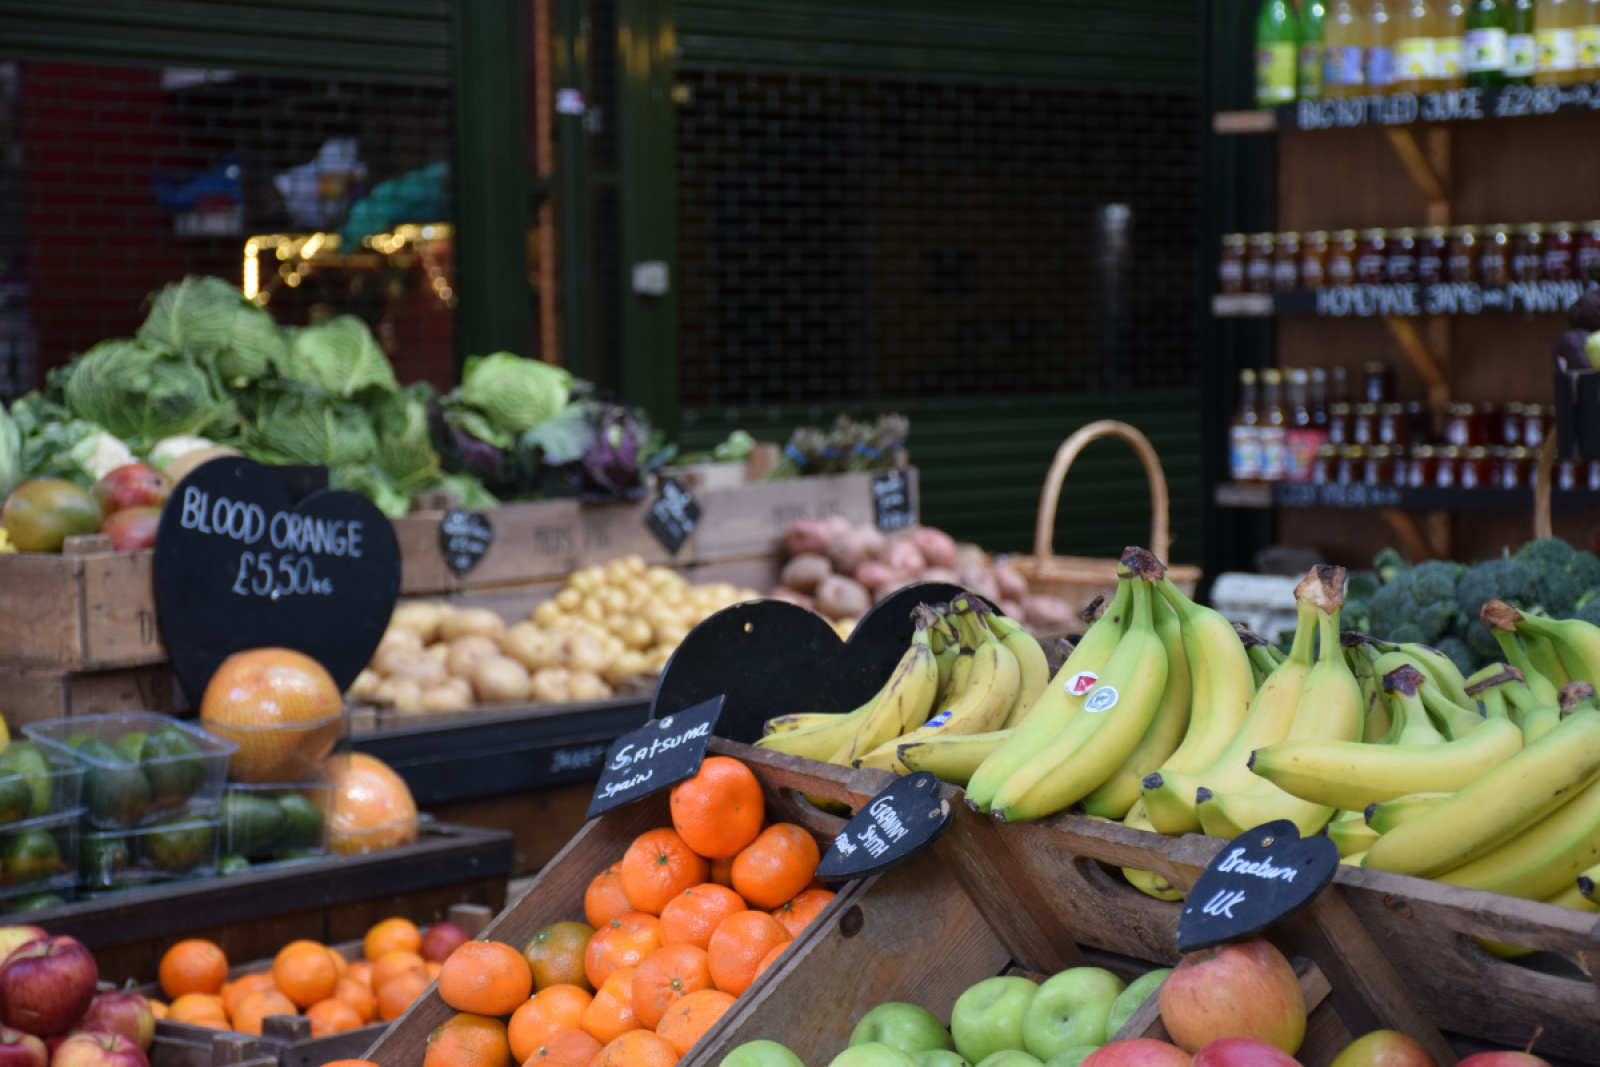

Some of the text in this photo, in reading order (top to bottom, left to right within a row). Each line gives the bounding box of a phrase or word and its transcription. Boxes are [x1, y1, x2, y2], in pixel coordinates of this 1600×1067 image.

[1335, 91, 1419, 127] BOTTLED
[1421, 87, 1485, 121] JUICE
[1316, 283, 1422, 317] HOMEMADE
[1423, 281, 1482, 315] JAMS
[180, 486, 364, 558] BLOOD ORANGE
[868, 795, 909, 844] GRANNY
[856, 823, 890, 859] SMITH
[1202, 889, 1246, 919] UK
